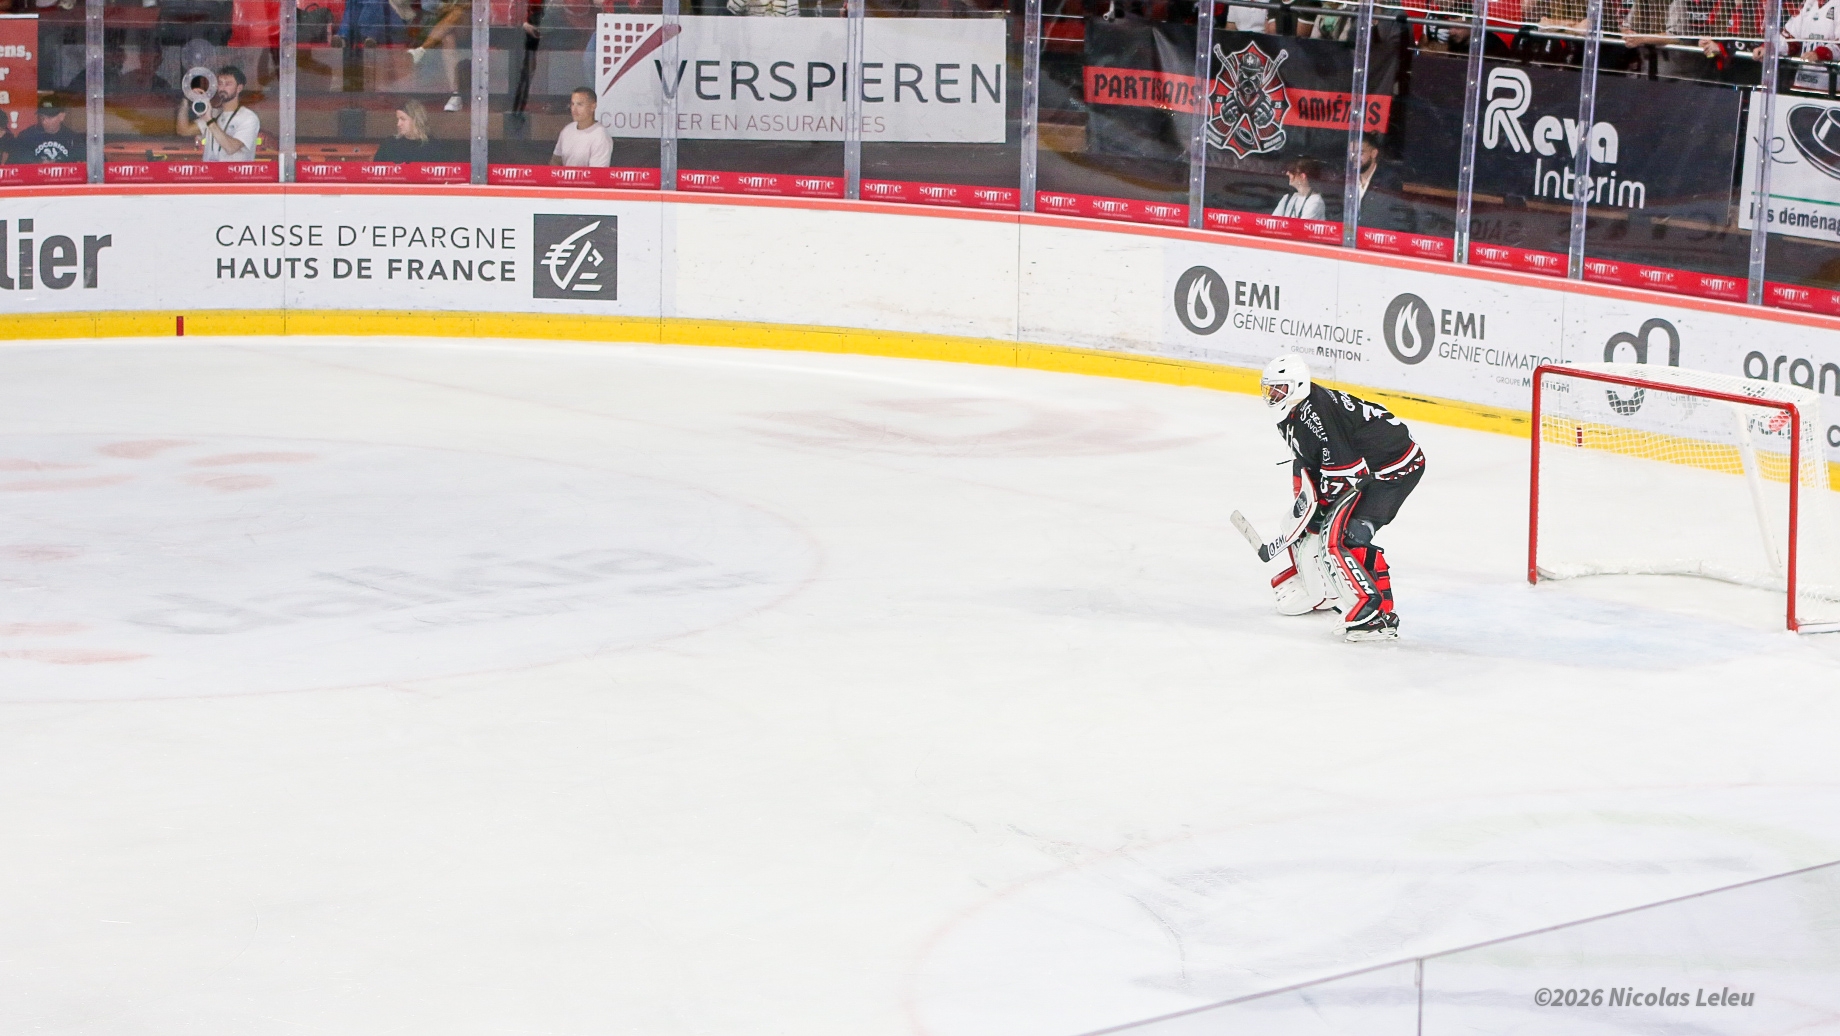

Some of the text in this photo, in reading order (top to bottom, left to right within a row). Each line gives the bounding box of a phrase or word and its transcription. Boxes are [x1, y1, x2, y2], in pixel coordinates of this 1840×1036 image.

[654, 59, 1002, 103] VERSPIEREN
[1483, 67, 1619, 164] Reva
[711, 114, 738, 131] EN
[35, 141, 69, 157] COCORICO
[38, 166, 77, 177] somme
[109, 165, 149, 176] somme
[168, 165, 208, 176] somme
[228, 165, 268, 175] somme
[302, 165, 341, 175] somme
[361, 165, 401, 175] somme
[421, 165, 461, 176] somme
[492, 167, 532, 178] somme
[551, 169, 590, 180] somme
[610, 171, 649, 181] somme
[681, 173, 719, 185] somme
[738, 176, 776, 188] somme
[795, 178, 833, 190] somme
[1534, 158, 1645, 209] Interim
[864, 182, 901, 194] somme
[919, 185, 956, 198] somme
[974, 189, 1011, 201] somme
[1040, 194, 1075, 207] somme
[1093, 199, 1128, 212] somme
[1144, 204, 1180, 217] somme
[1207, 211, 1240, 224] somme
[1255, 216, 1288, 230] somme
[1779, 207, 1840, 237] déména
[1303, 223, 1336, 236] somme
[216, 225, 516, 249] CAISSE D'EPARGNE
[1364, 231, 1396, 244] somme
[1411, 237, 1444, 251] somme
[1475, 246, 1508, 260] somme
[1524, 253, 1557, 267] somme
[1584, 257, 1619, 274] somme
[216, 258, 516, 281] HAUTS DE FRANCE
[1640, 268, 1673, 282] somme
[1701, 277, 1735, 291] somme
[1234, 280, 1280, 311] EMI
[1773, 287, 1809, 301] somme
[1233, 310, 1364, 346] GÉNIE CLIMATIQUE
[1441, 309, 1485, 340] EMI
[1291, 345, 1361, 362] GROUPE MENTION
[1439, 338, 1481, 363] GÉNIE
[1496, 376, 1520, 387] GROUPE
[1344, 556, 1375, 595] CCM
